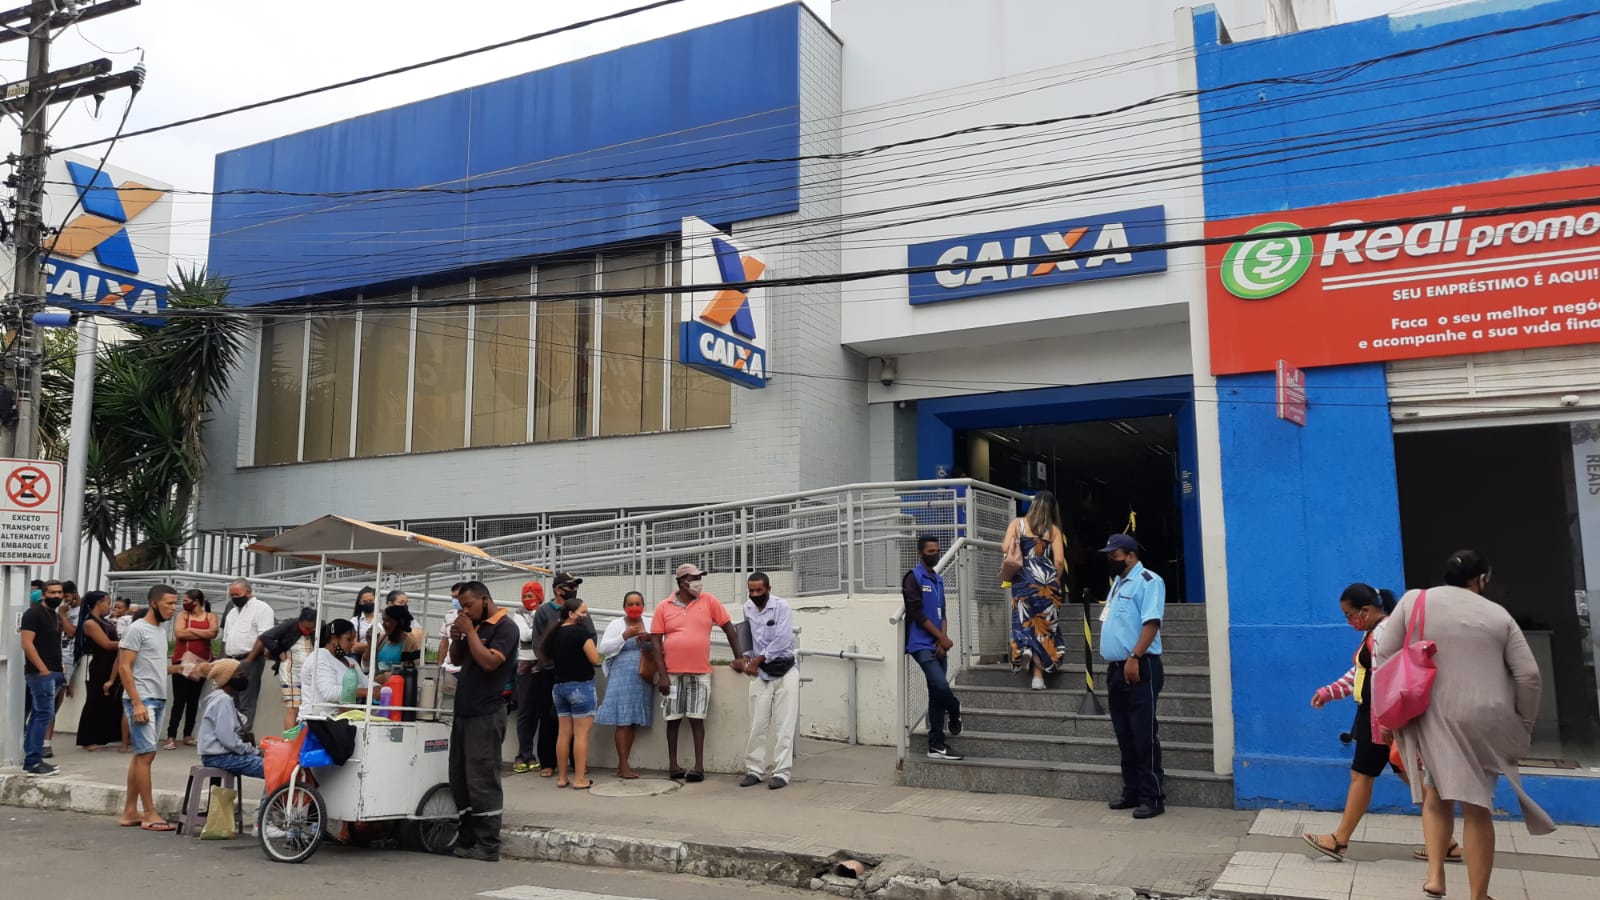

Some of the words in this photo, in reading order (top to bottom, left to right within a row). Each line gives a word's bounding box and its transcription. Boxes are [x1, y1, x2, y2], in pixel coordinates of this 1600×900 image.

[1320, 206, 1467, 268] Real
[934, 222, 1133, 289] CAIXA
[1392, 288, 1421, 301] SEU
[1426, 278, 1529, 297] EMPRÉSTIMO
[1534, 272, 1544, 286] É
[1548, 267, 1599, 284] AQUI!
[1391, 315, 1428, 330] Faca
[1437, 315, 1448, 326] o
[1452, 312, 1481, 324] seu
[1486, 305, 1547, 321] melhor
[1553, 298, 1600, 315] negó
[1358, 339, 1368, 349] e
[1372, 330, 1467, 348] acompanhe
[1472, 328, 1483, 339] a
[1488, 325, 1518, 338] sua
[1523, 320, 1561, 334] vida
[699, 332, 763, 379] CAIXA
[1, 533, 51, 541] ALTERNATIVO
[2, 523, 50, 531] TRANSPORTE
